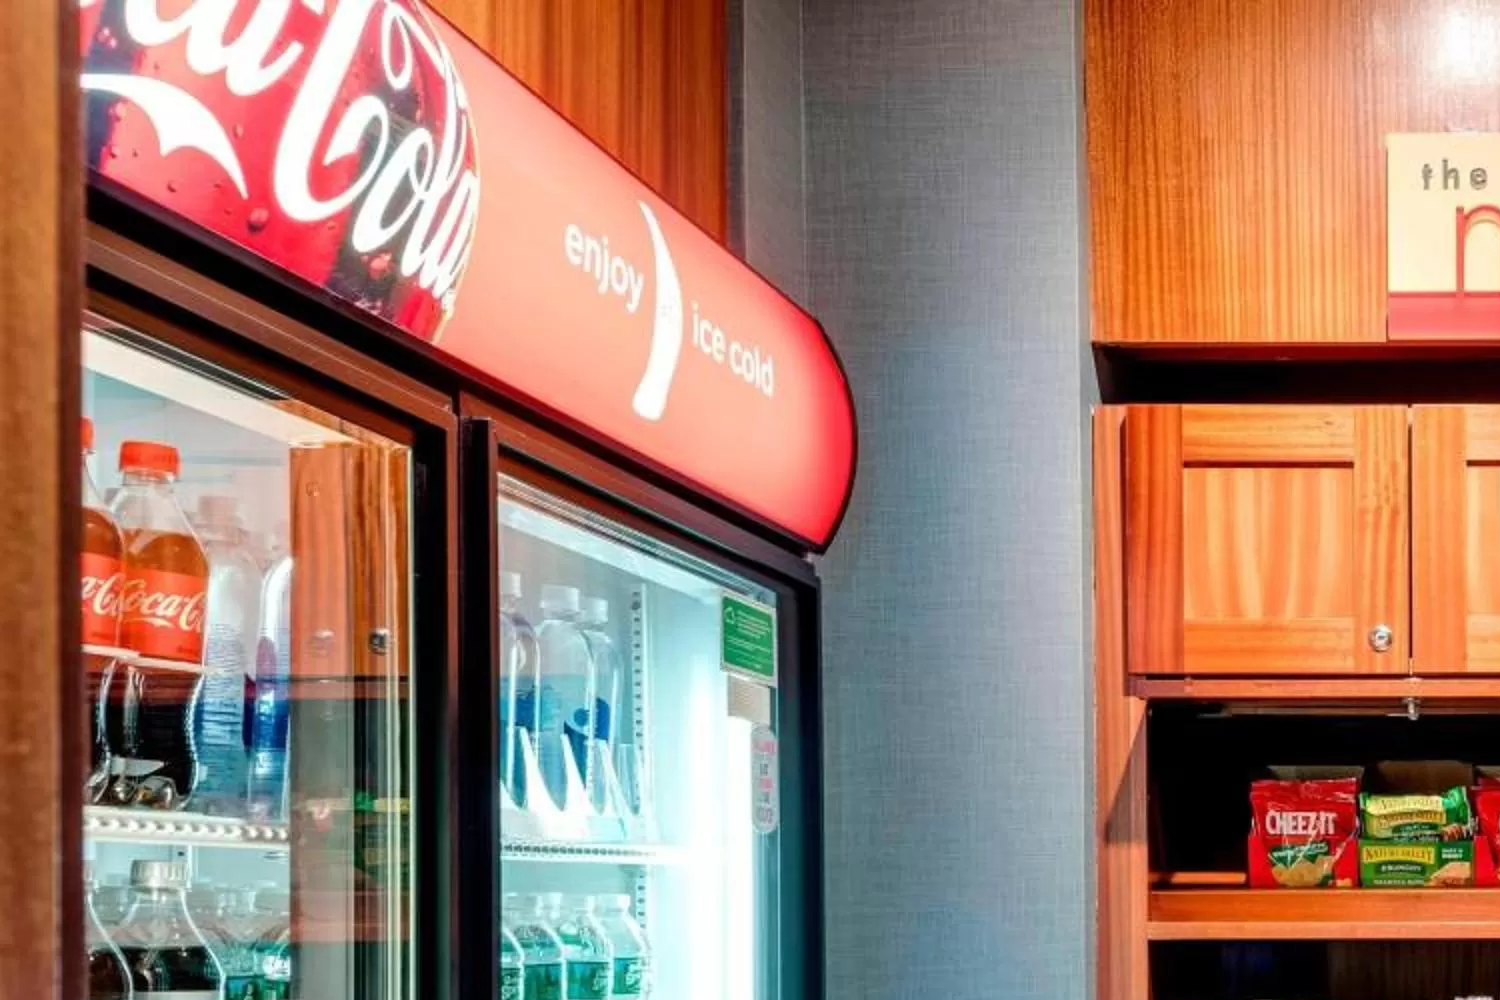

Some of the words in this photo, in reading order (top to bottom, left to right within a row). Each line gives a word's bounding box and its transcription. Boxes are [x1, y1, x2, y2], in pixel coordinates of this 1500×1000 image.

[1421, 160, 1489, 191] the
[564, 223, 644, 314] enjoy
[692, 299, 726, 364] ice
[729, 340, 774, 398] cold
